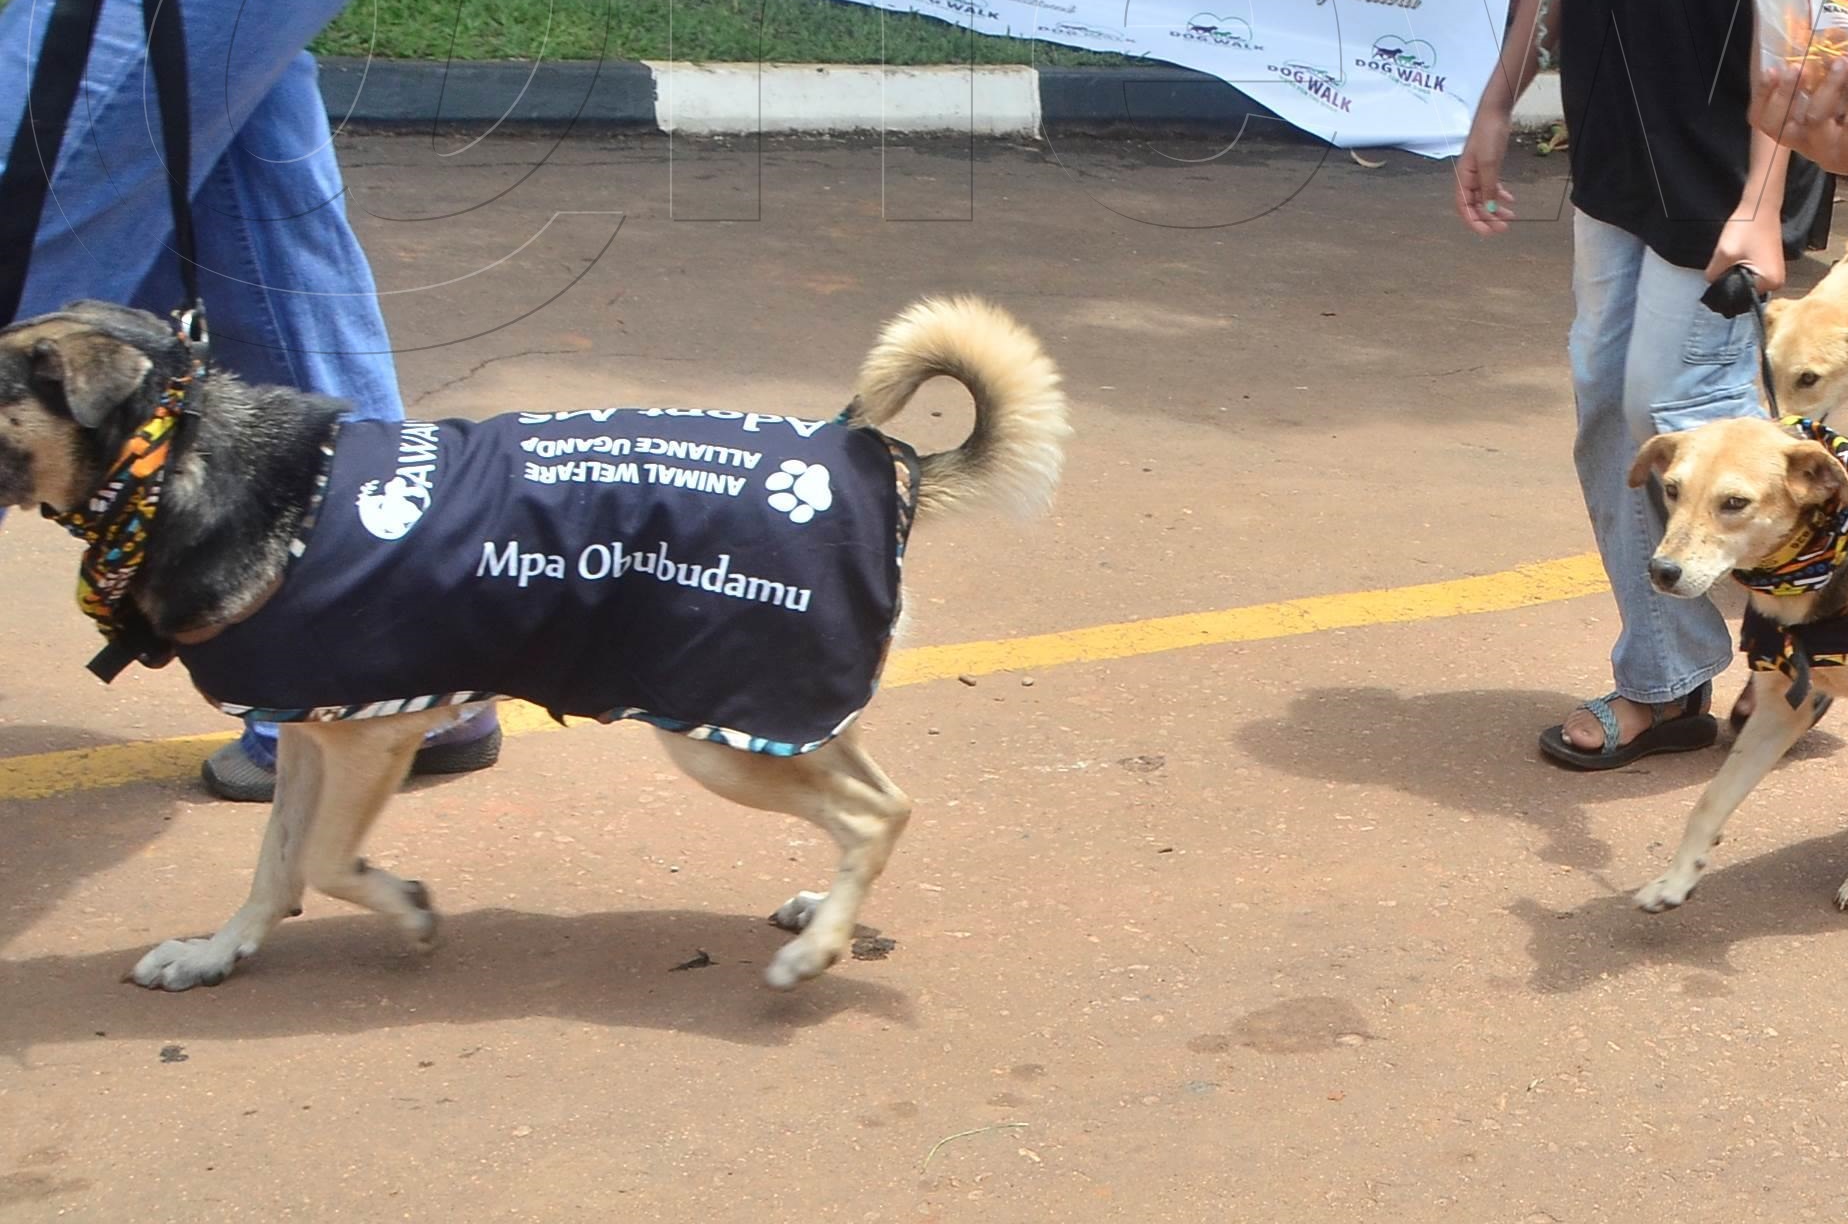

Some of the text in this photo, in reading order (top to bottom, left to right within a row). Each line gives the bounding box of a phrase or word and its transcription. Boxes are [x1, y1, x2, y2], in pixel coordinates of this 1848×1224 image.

[948, 0, 1000, 20] WALK
[1267, 64, 1304, 84] DOG
[1307, 76, 1353, 114] WALK
[1355, 58, 1392, 74] DOG
[1397, 67, 1446, 93] WALK
[634, 437, 763, 470] ALLIANCE
[524, 461, 747, 497] ANIMAL WELFARE
[476, 541, 565, 588] Mpa
